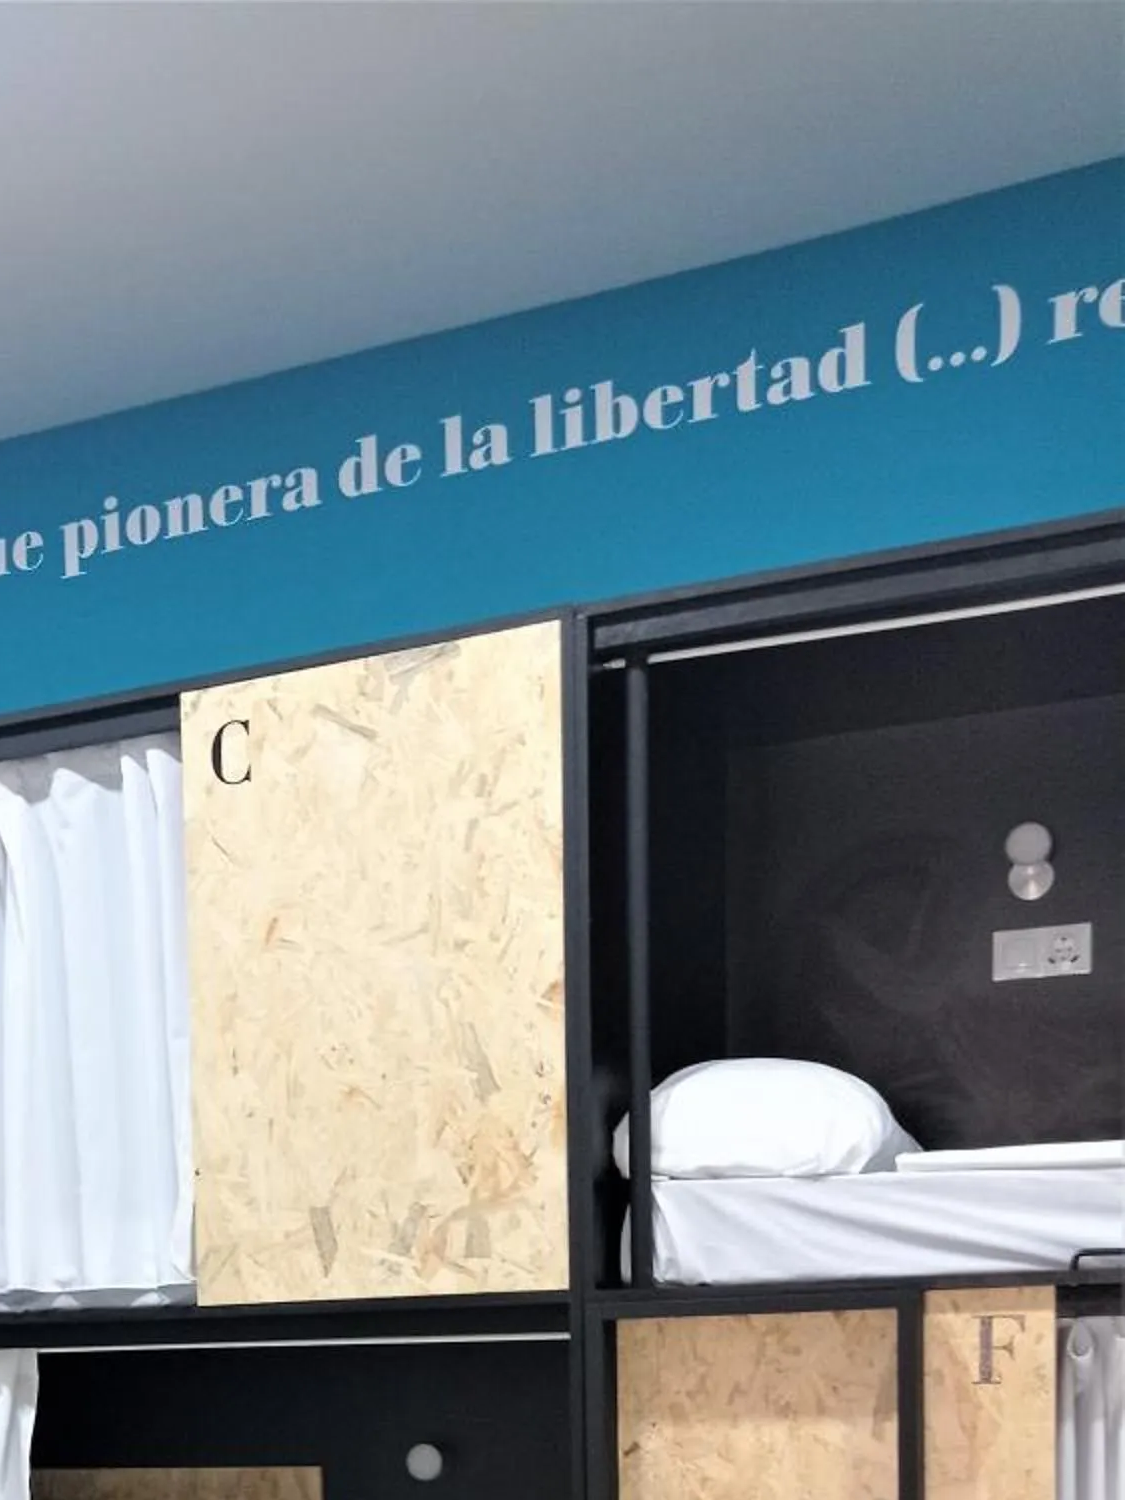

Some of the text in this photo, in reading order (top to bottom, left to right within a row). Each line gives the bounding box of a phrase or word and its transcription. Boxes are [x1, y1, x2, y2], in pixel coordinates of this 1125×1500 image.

[60, 467, 320, 578] pionera
[338, 435, 421, 498] de
[441, 415, 511, 477] la
[530, 322, 870, 457] libertad
[211, 719, 253, 785] C
[972, 1315, 1025, 1385] F
